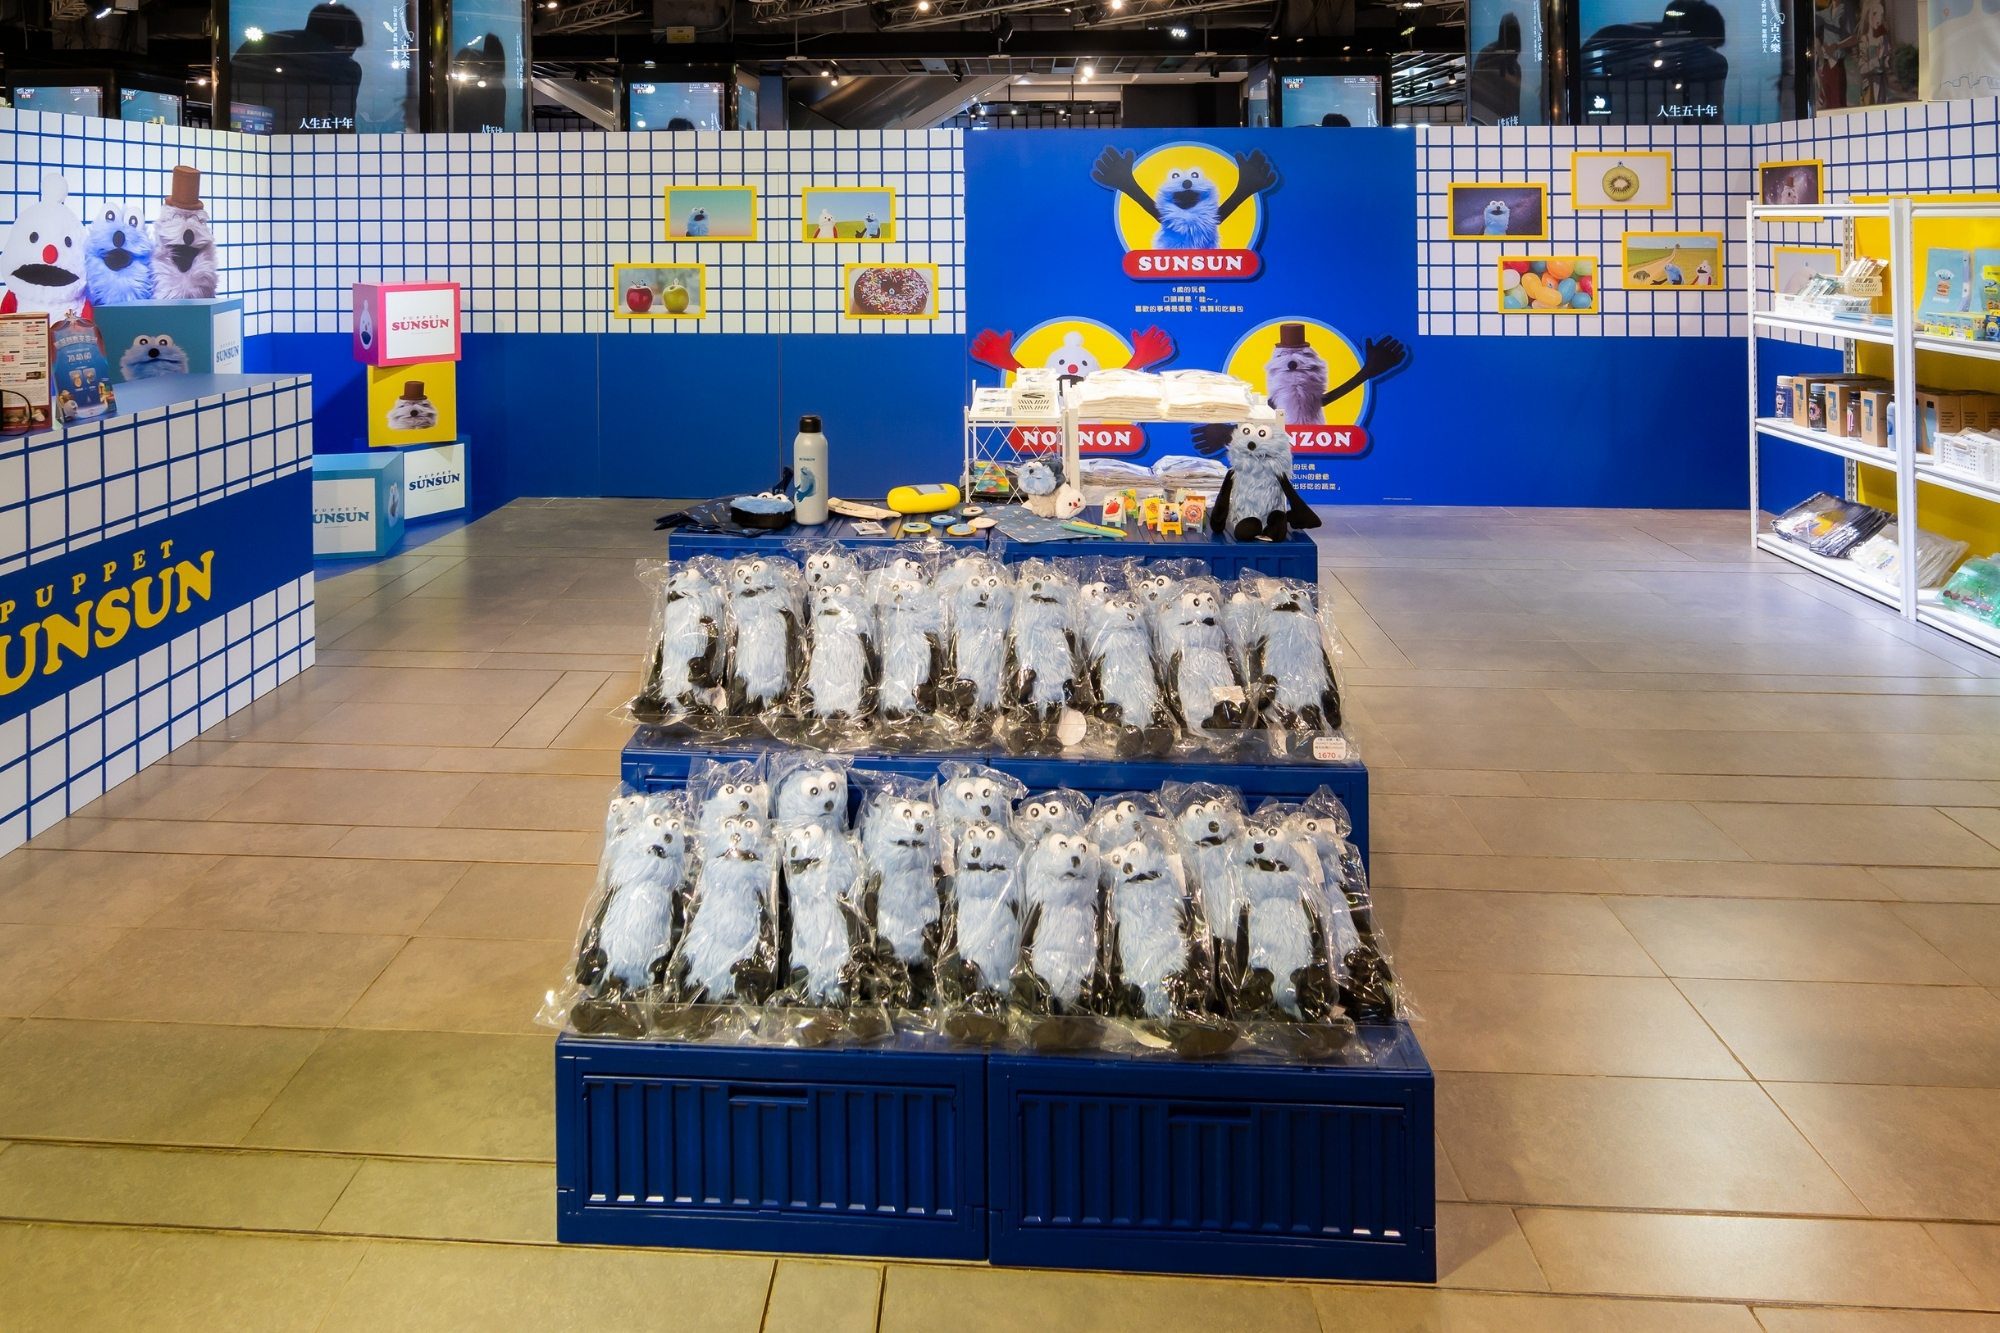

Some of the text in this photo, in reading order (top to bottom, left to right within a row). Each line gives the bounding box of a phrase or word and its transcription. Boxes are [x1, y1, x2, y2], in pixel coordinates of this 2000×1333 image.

[1770, 22, 1780, 53] 古天樂
[1657, 104, 1718, 117] 人生五十年
[299, 117, 353, 129] 人生五十年
[1138, 255, 1243, 271] SUNSUN
[391, 318, 449, 331] SUNSUN
[1022, 430, 1132, 446] NONON
[1287, 431, 1351, 447] NZON
[1291, 463, 1316, 471] 的玩偶
[409, 473, 460, 491] SUNSUN
[313, 511, 370, 524] UNSUN
[0, 540, 173, 623] PUPPET
[0, 550, 215, 696] UNSUN
